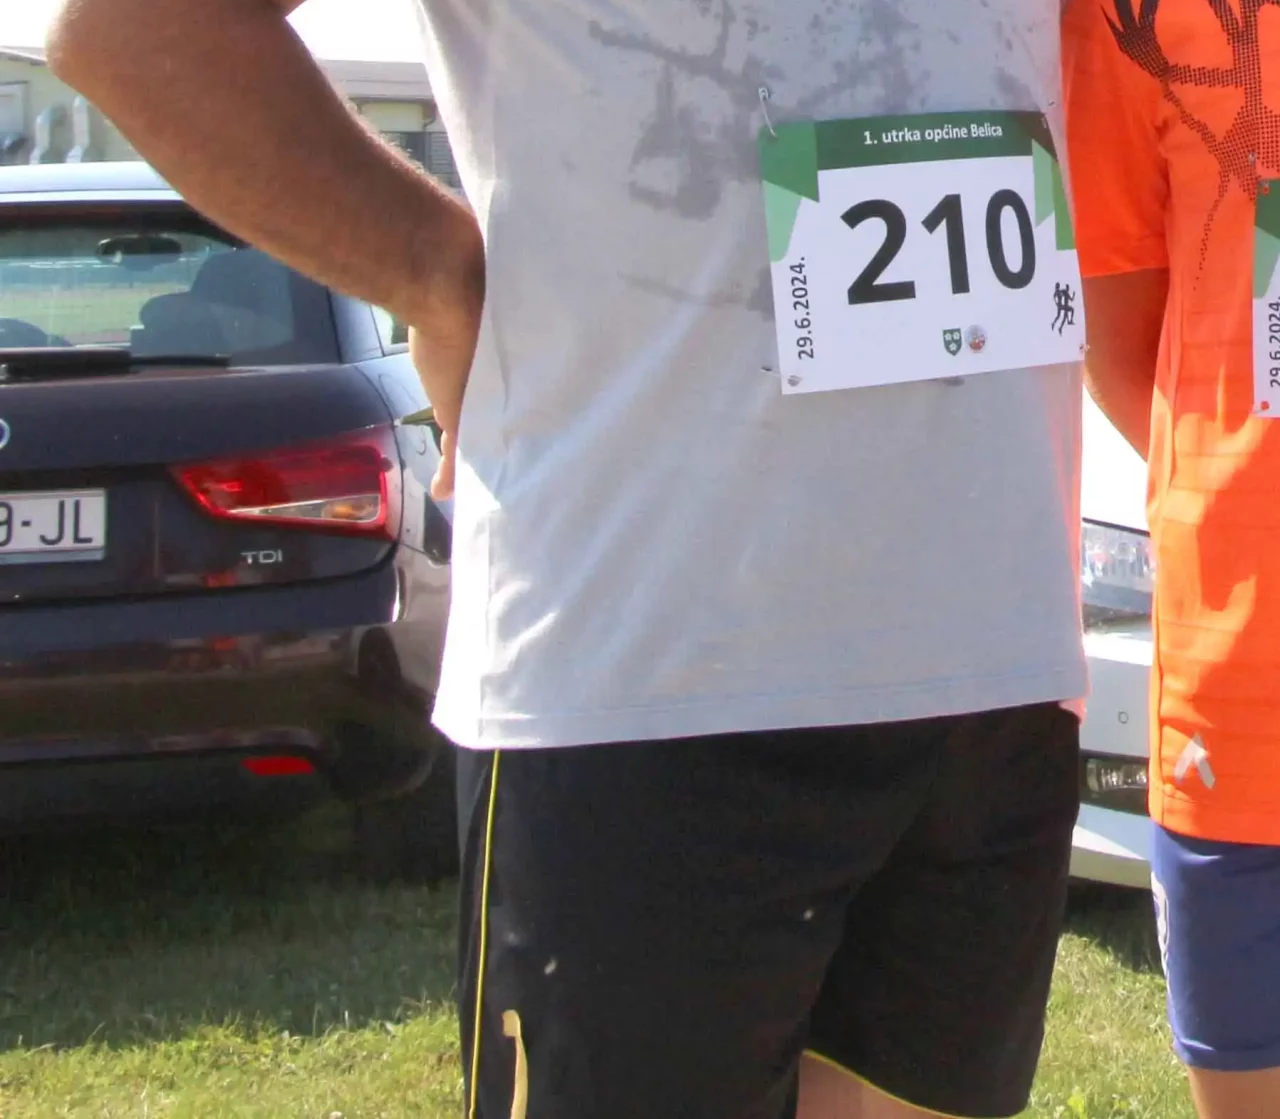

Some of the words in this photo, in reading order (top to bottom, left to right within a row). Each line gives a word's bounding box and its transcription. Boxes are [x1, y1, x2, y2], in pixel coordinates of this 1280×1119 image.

[863, 131, 878, 145] 1.
[882, 127, 921, 143] utrka
[925, 124, 969, 142] općine
[970, 122, 1003, 137] Belica
[840, 189, 1036, 305] 210
[789, 256, 814, 360] 29.6.2024.
[241, 549, 283, 564] TDI
